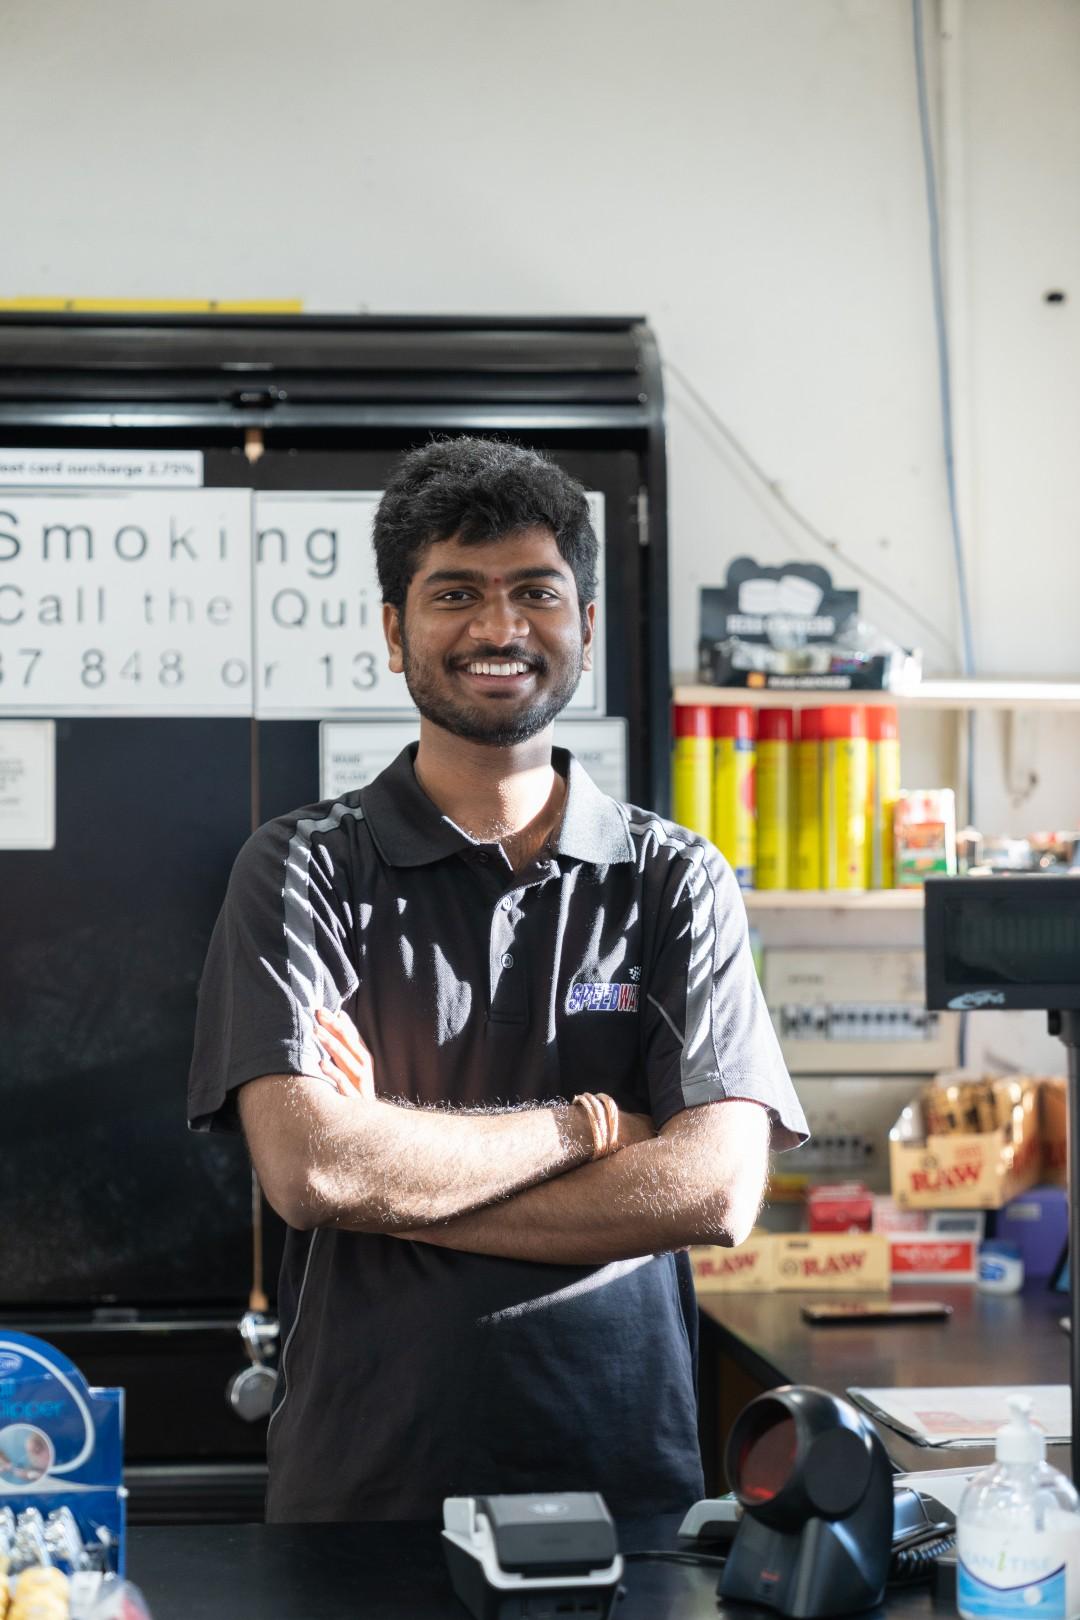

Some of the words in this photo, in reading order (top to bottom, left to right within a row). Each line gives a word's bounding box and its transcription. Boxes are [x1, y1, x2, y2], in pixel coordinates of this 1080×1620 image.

[29, 460, 63, 473] card
[68, 460, 143, 477] surcharge
[0, 510, 338, 579] Smoking
[0, 584, 105, 626] Call
[143, 586, 232, 626] the
[271, 587, 369, 629] Qui
[0, 648, 43, 690] 7
[81, 648, 185, 690] 848
[221, 655, 279, 690] or
[568, 983, 640, 1012] SPEEDWA
[910, 1163, 984, 1192] RAW
[697, 1252, 760, 1277] RAW
[802, 1252, 868, 1277] RAW
[0, 1397, 64, 1420] lipper
